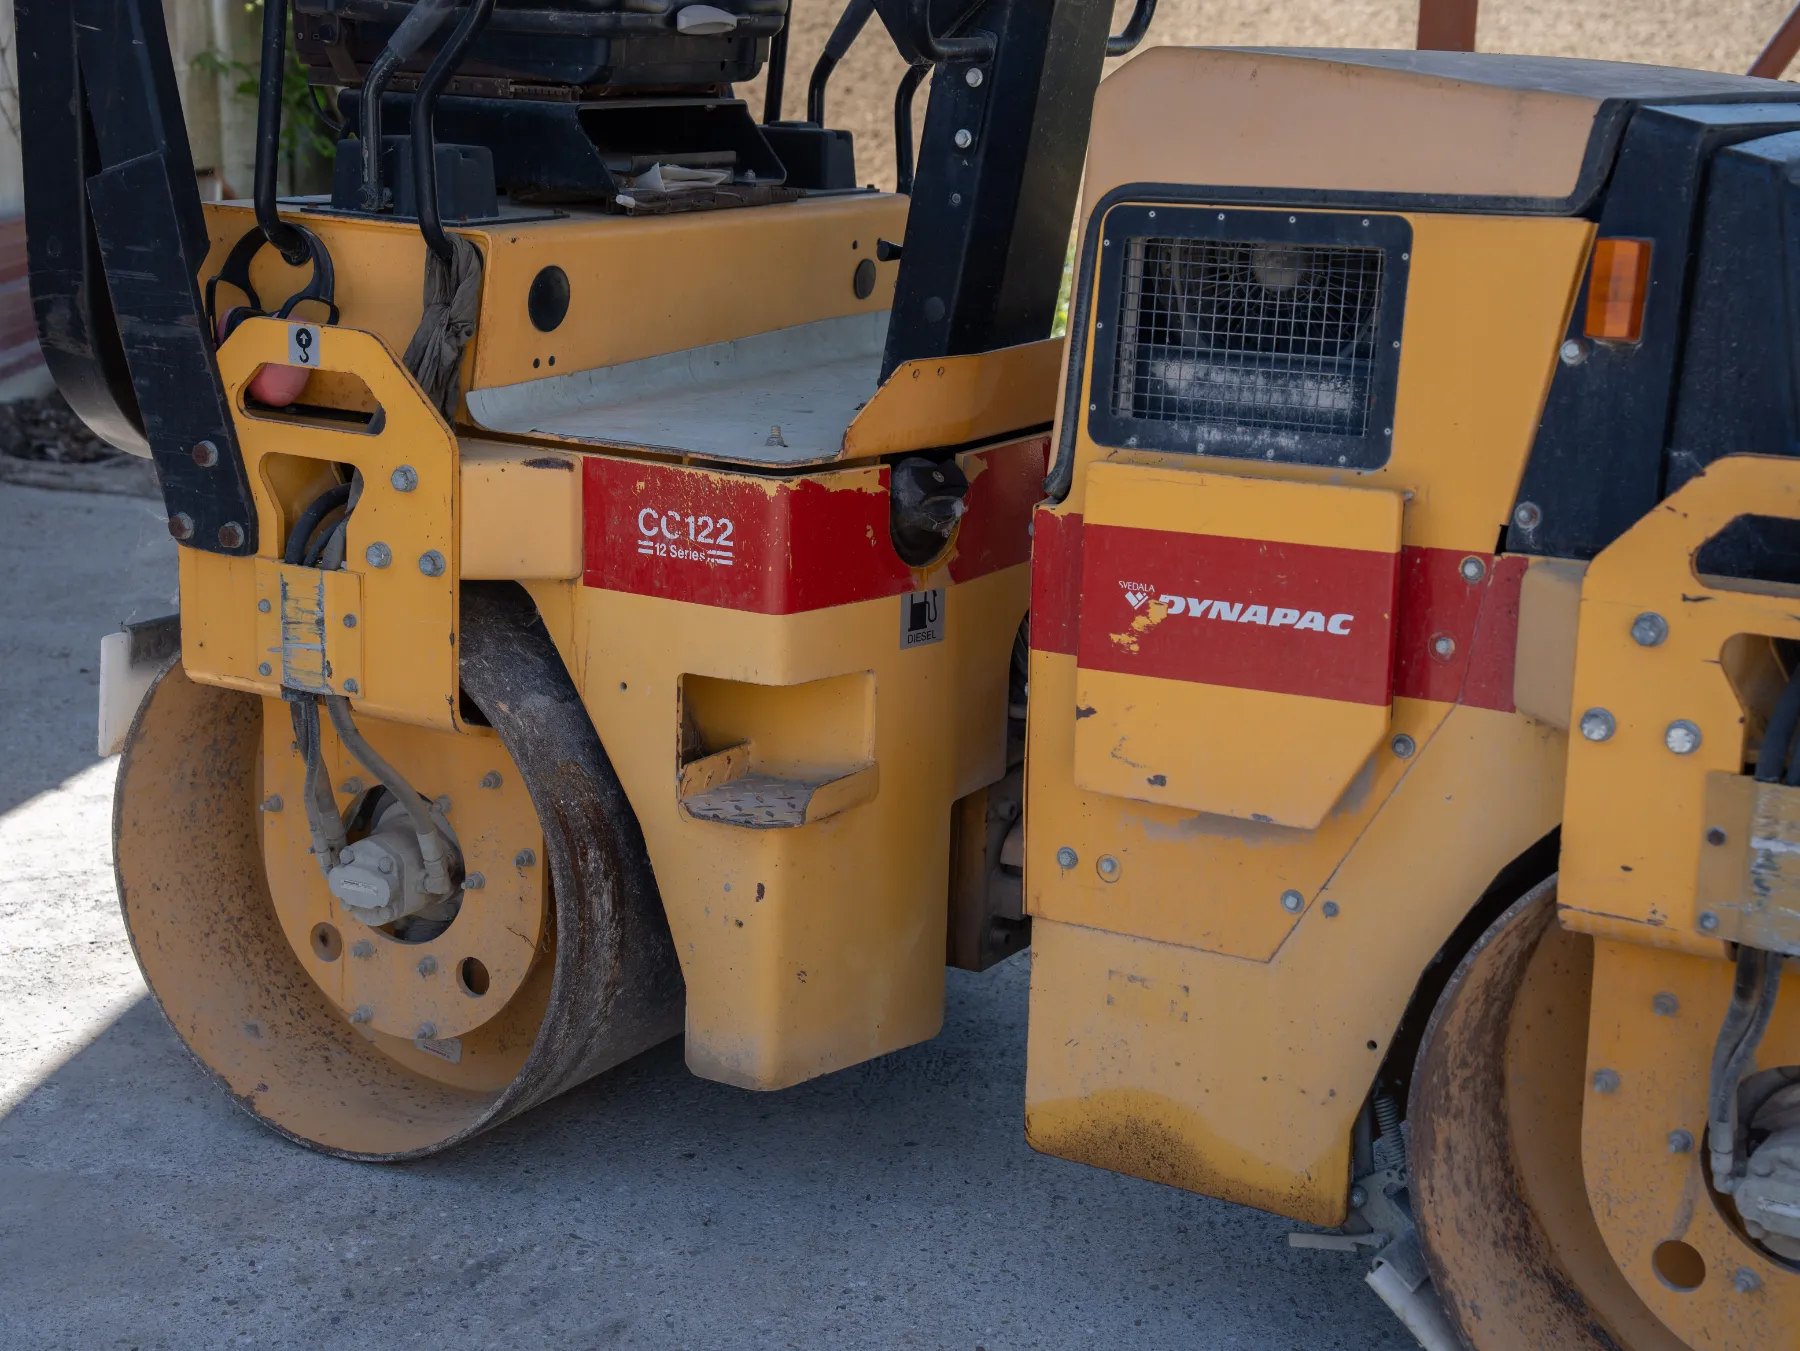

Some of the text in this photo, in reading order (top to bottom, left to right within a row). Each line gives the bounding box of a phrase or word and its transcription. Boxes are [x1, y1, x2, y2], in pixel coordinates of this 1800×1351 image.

[654, 542, 706, 562] 12 Series
[1118, 580, 1155, 593] SVEDALA
[1158, 594, 1354, 635] DYNAPAC
[907, 630, 937, 644] DIESEL
